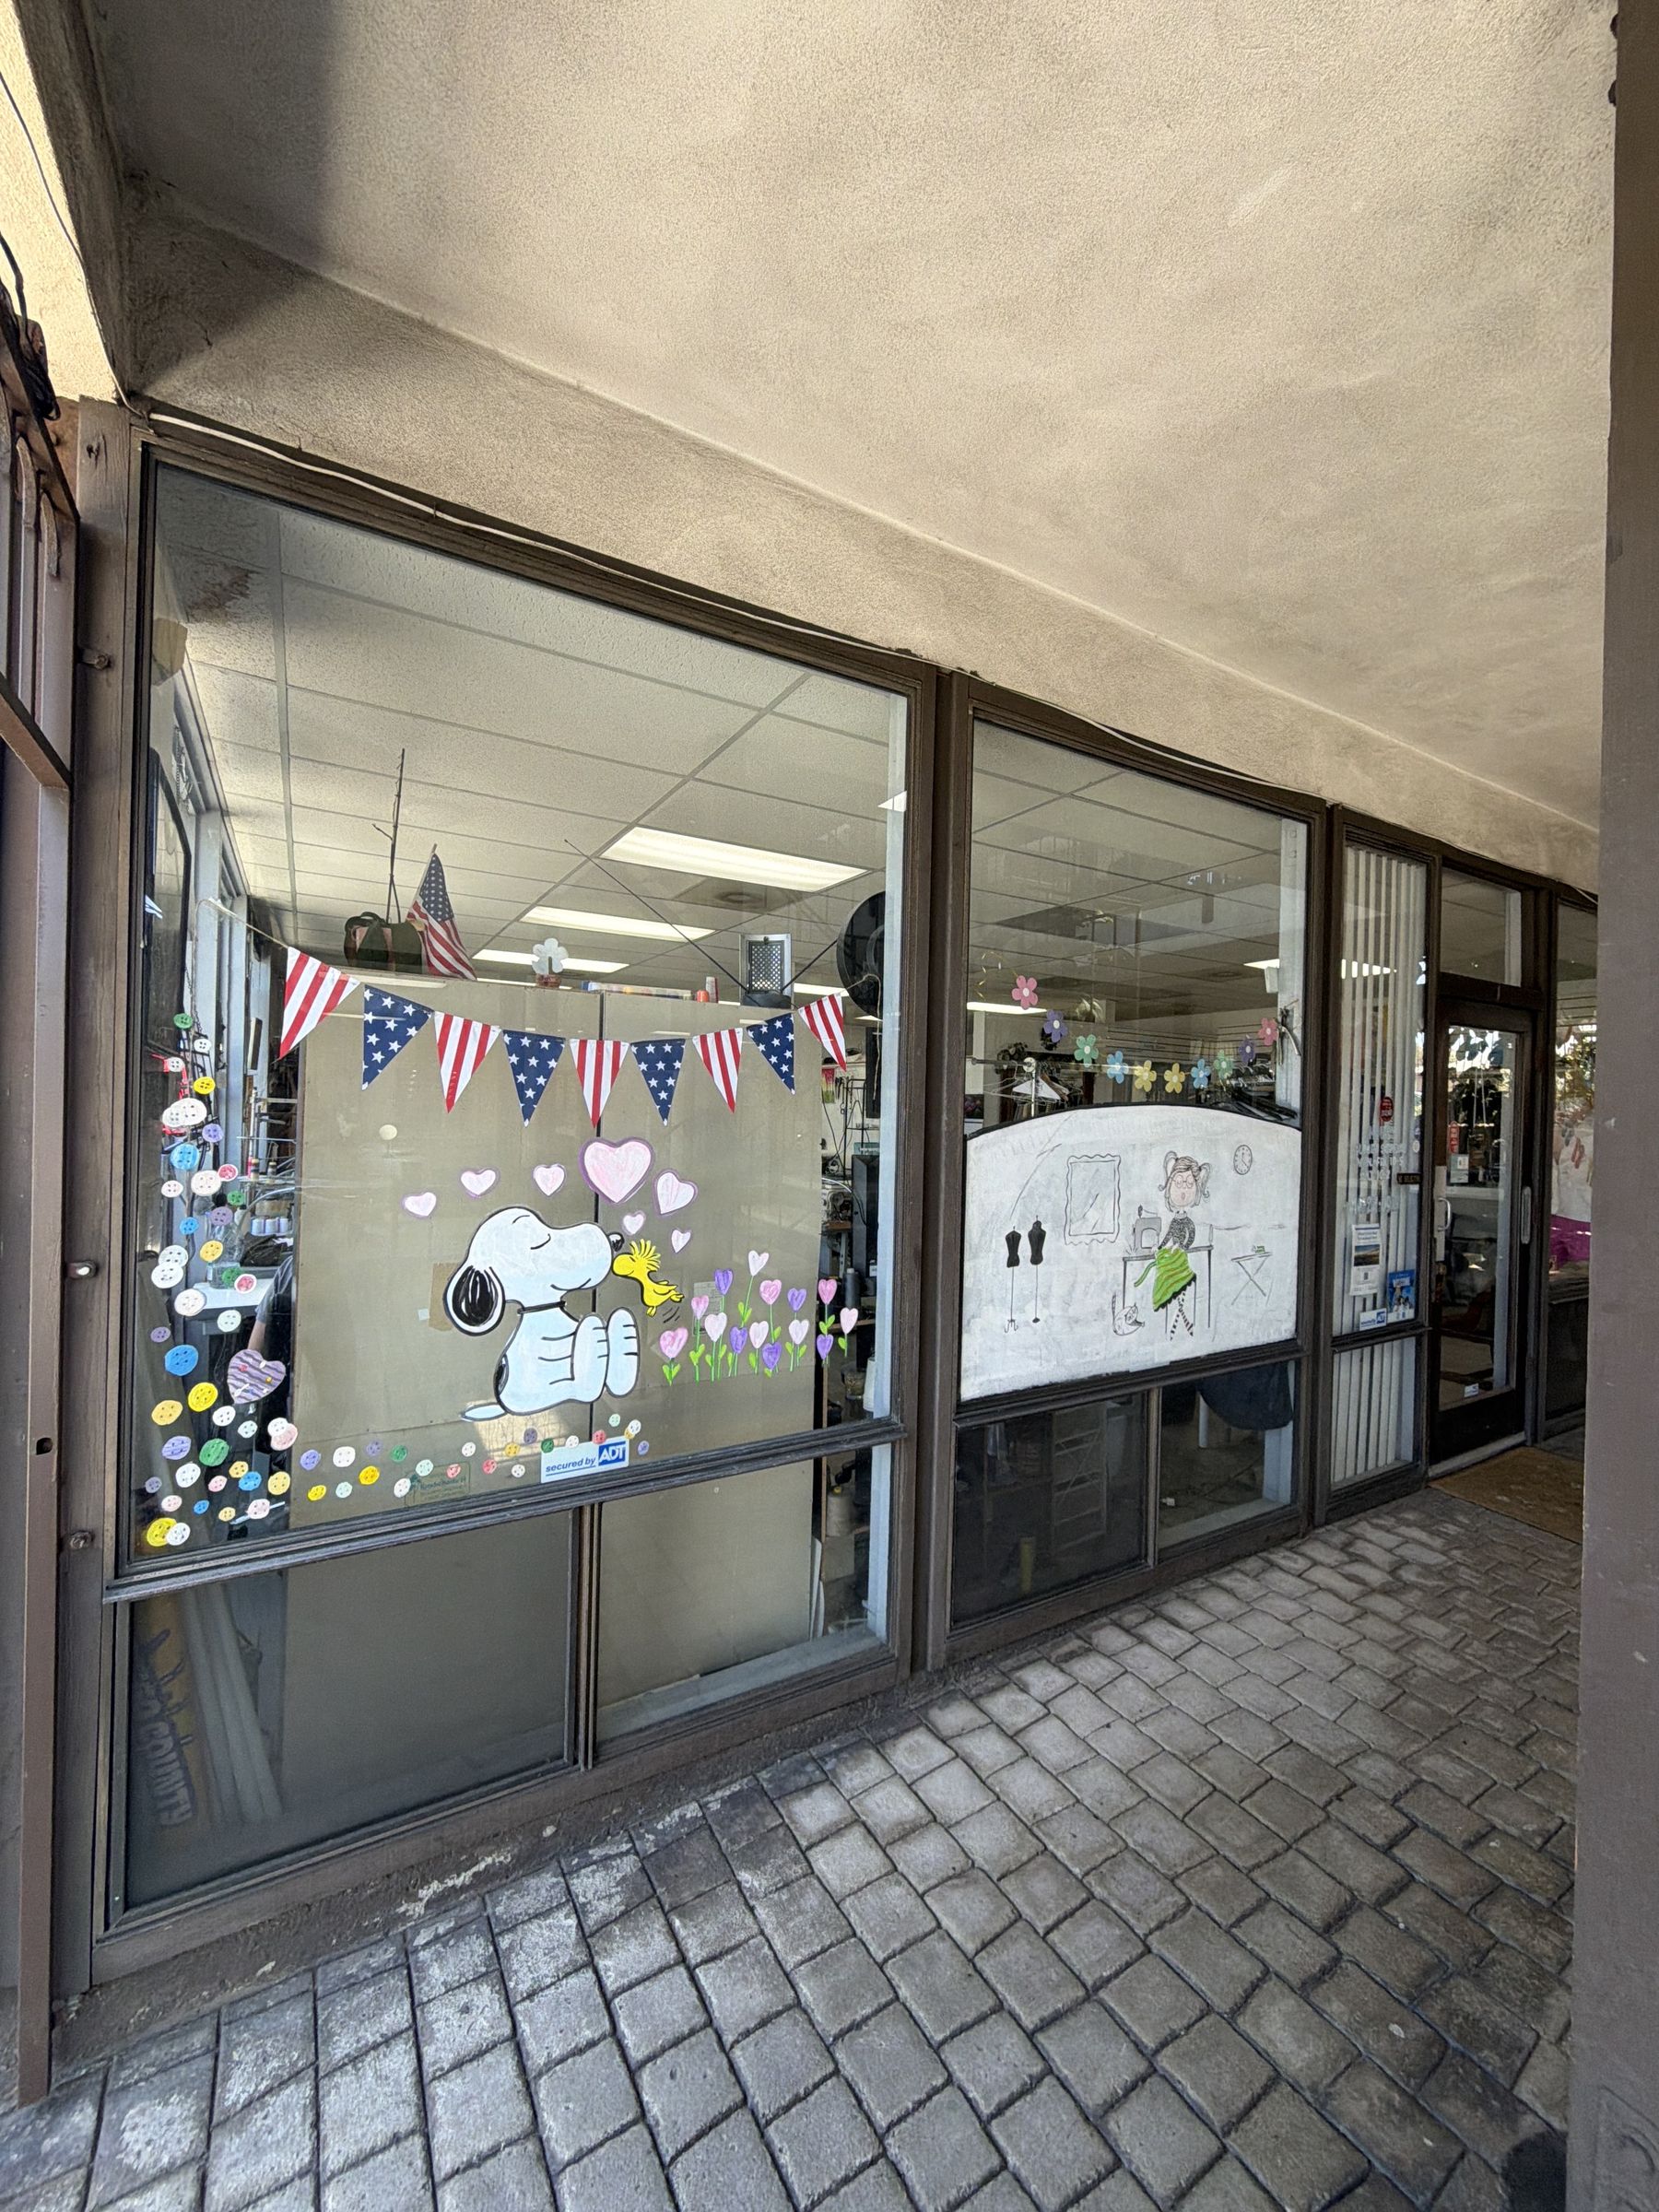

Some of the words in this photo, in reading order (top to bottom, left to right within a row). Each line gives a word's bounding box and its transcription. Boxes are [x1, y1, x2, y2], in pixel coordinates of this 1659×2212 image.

[546, 1458, 583, 1473] secured
[585, 1456, 596, 1465] by
[598, 1444, 626, 1464] ADT
